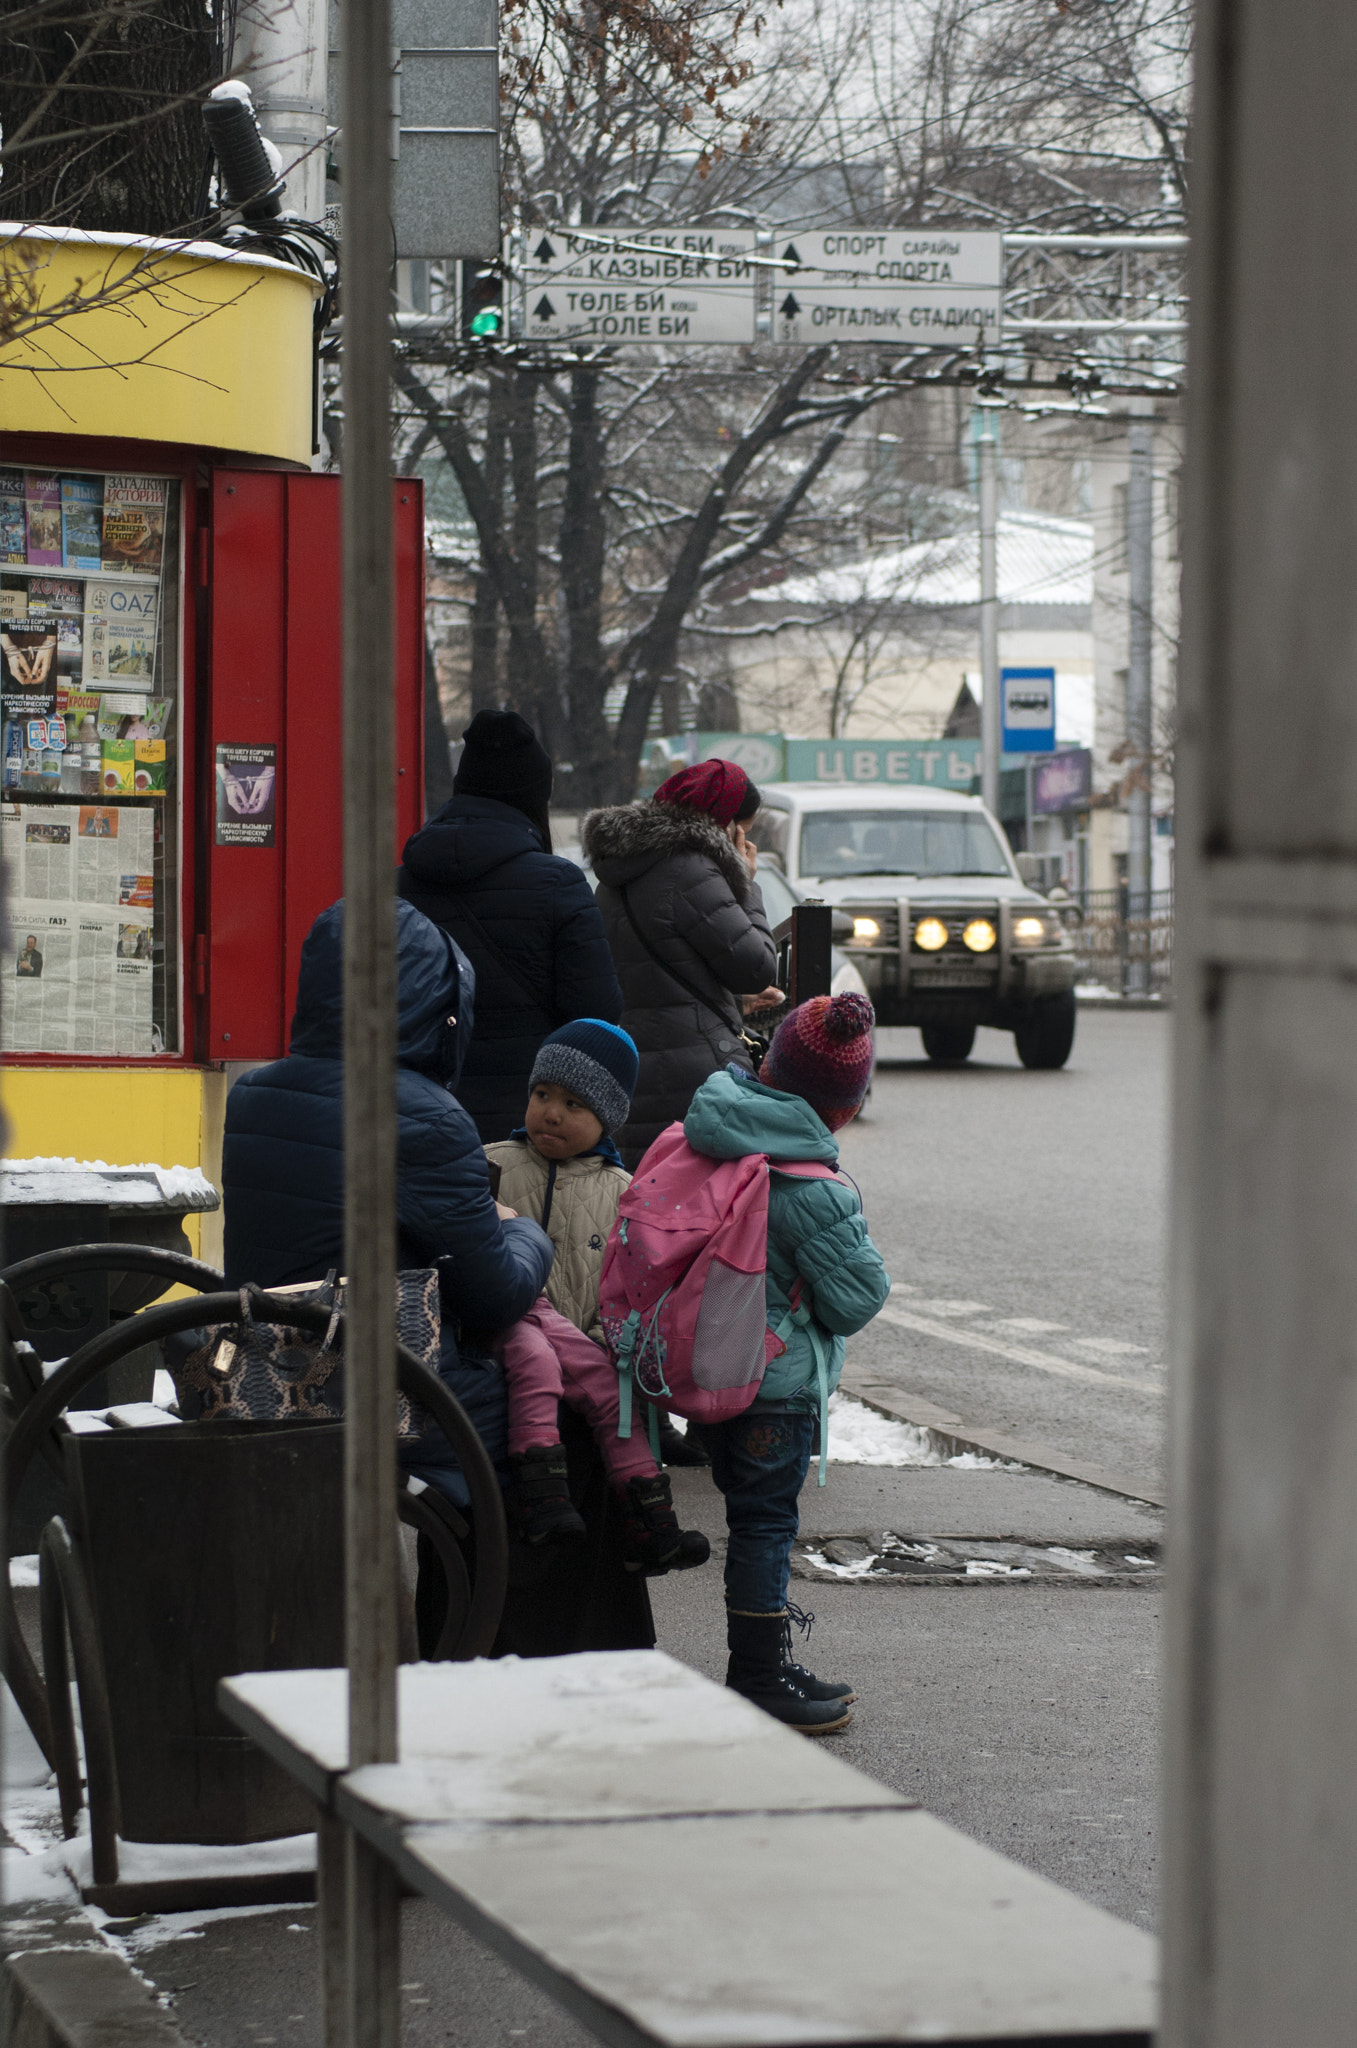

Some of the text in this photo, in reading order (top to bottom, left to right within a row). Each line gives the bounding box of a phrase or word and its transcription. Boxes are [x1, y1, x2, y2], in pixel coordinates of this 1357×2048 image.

[683, 235, 713, 253] БИ
[823, 236, 961, 256] СПОРТ САРАЙЫ
[589, 258, 711, 278] КАЗЫБЕК
[717, 260, 750, 278] БИ
[876, 261, 952, 282] СПОРТА
[566, 292, 628, 312] ТӨЛЕ
[634, 293, 665, 312] БИ
[588, 316, 650, 335] ТОЛЕ
[658, 317, 689, 335] БИ
[811, 306, 996, 330] ОРТАЛЫҚ СТАДИОН
[108, 476, 162, 490] ЗАГАДКИ
[107, 488, 163, 503] ИСТОРИИ
[106, 513, 143, 524] МАГИ
[105, 532, 138, 540] ЕГИПТА
[106, 524, 148, 533] ДРЕВНЕГО
[815, 750, 982, 782] ЦВЕТЫ
[49, 917, 67, 926] ГАЗ?
